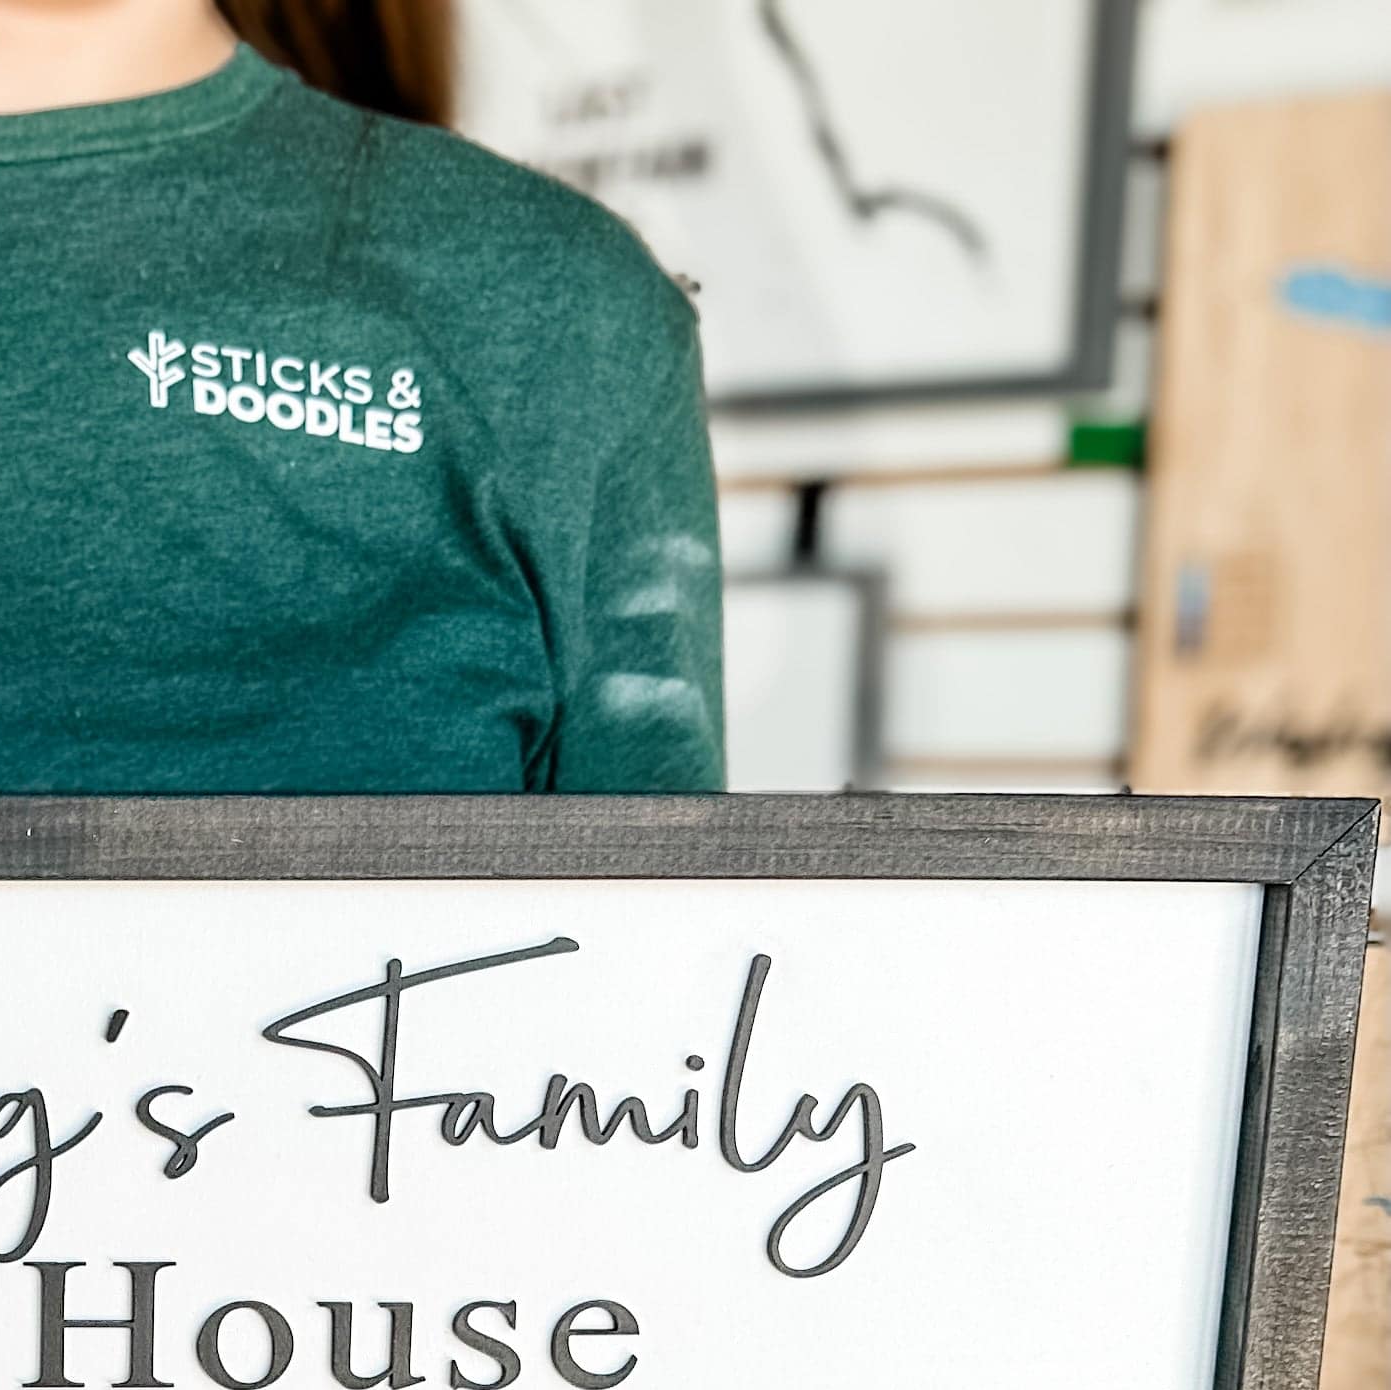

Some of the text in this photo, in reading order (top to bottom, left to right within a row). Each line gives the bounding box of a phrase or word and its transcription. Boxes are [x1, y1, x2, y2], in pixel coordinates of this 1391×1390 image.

[191, 342, 423, 410] STICKS &
[192, 376, 424, 454] DOODLES
[261, 935, 918, 1280] Family
